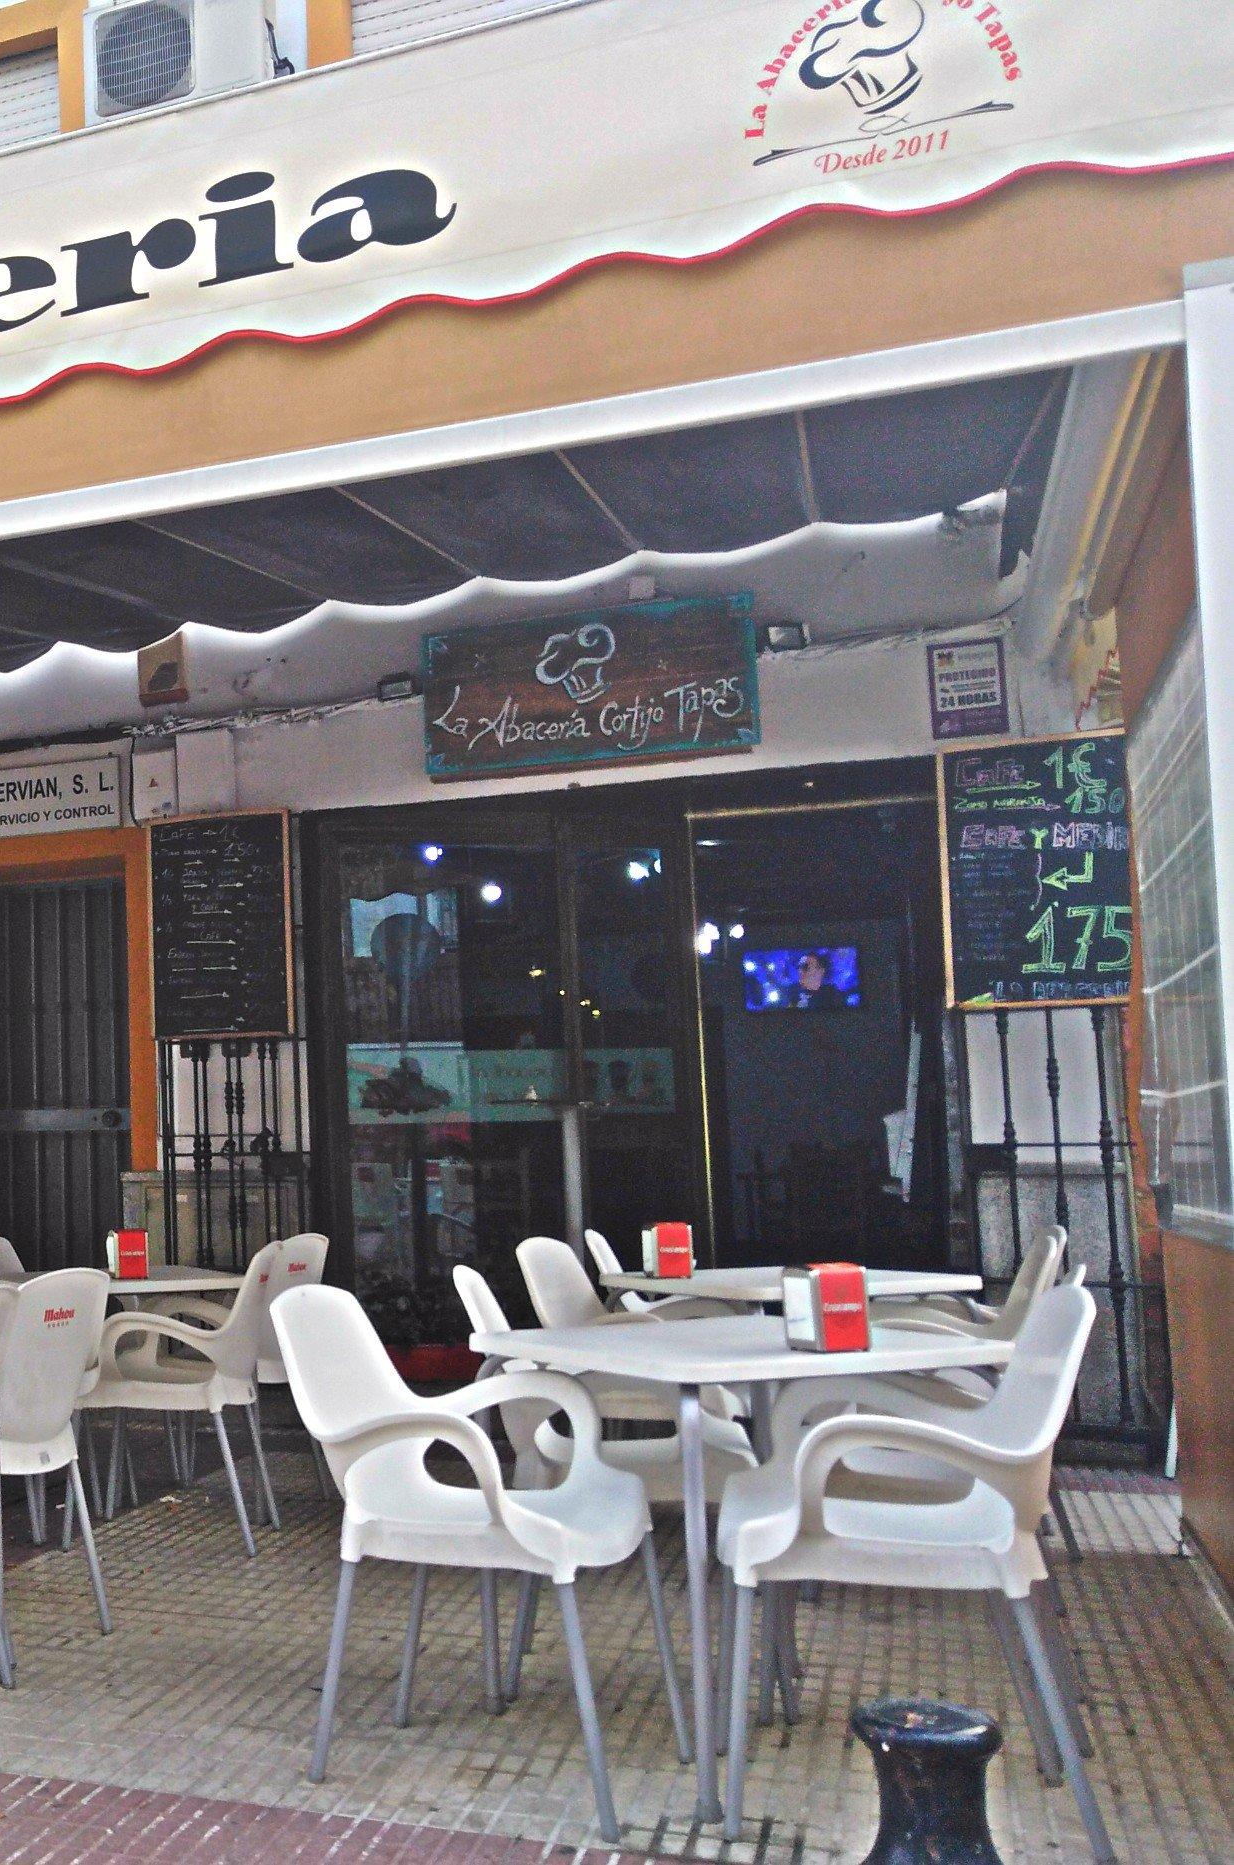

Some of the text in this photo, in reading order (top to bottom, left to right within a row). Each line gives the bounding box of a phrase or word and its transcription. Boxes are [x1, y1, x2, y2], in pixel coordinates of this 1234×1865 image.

[743, 104, 768, 139] La
[974, 2, 1022, 81] Tapas
[814, 129, 950, 174] Desde 2011
[432, 684, 469, 737] La
[599, 695, 664, 750] Cortijo
[664, 677, 745, 743] Tapas
[72, 774, 89, 794] S.
[99, 771, 114, 791] L.
[42, 810, 51, 822] Y
[54, 804, 115, 821] CONTROL
[44, 1307, 75, 1322] Mahou
